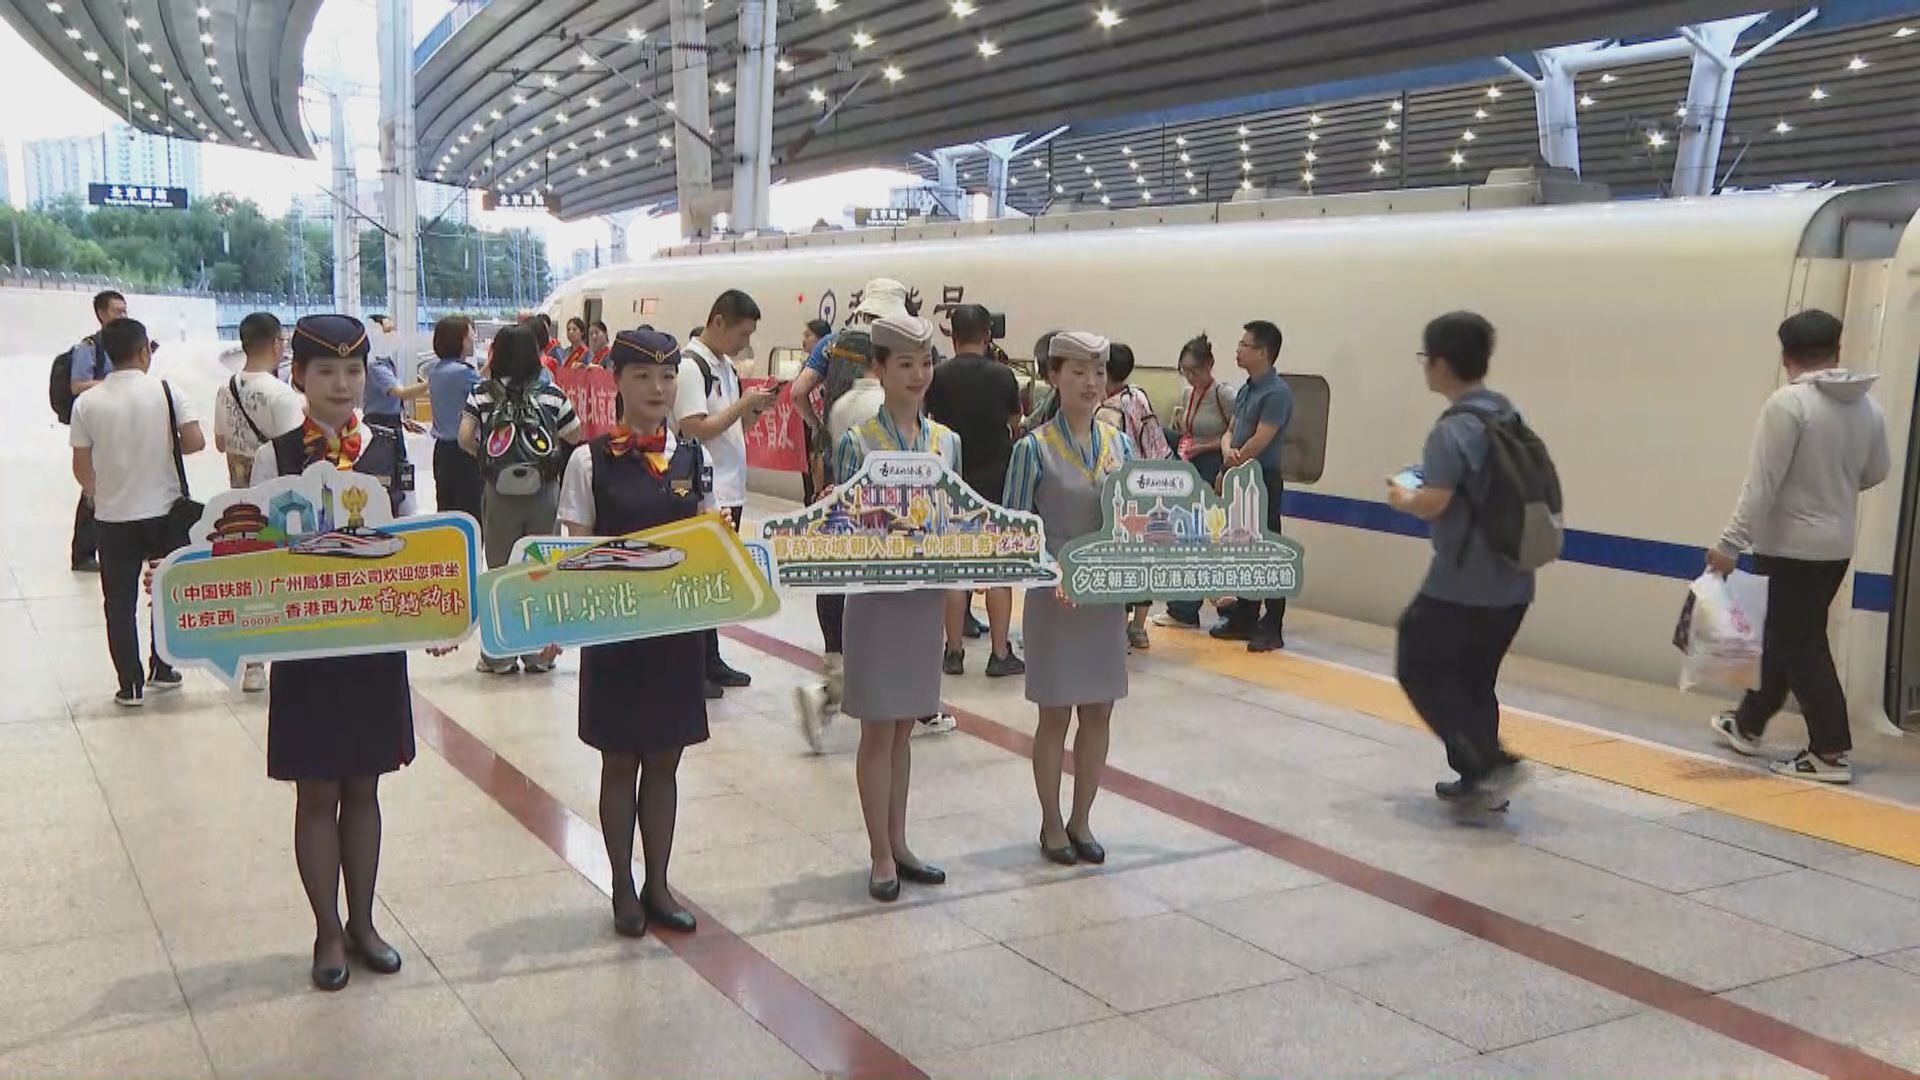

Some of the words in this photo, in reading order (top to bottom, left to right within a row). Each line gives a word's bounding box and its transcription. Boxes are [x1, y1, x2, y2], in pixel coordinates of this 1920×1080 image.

[110, 185, 167, 201] 北京西站
[499, 193, 545, 207] 北京西站
[172, 562, 459, 604] （中国铁路）广州局集团公司欢迎您乘坐
[516, 570, 733, 632] 千里京港一宿还
[178, 608, 235, 630] 北京西
